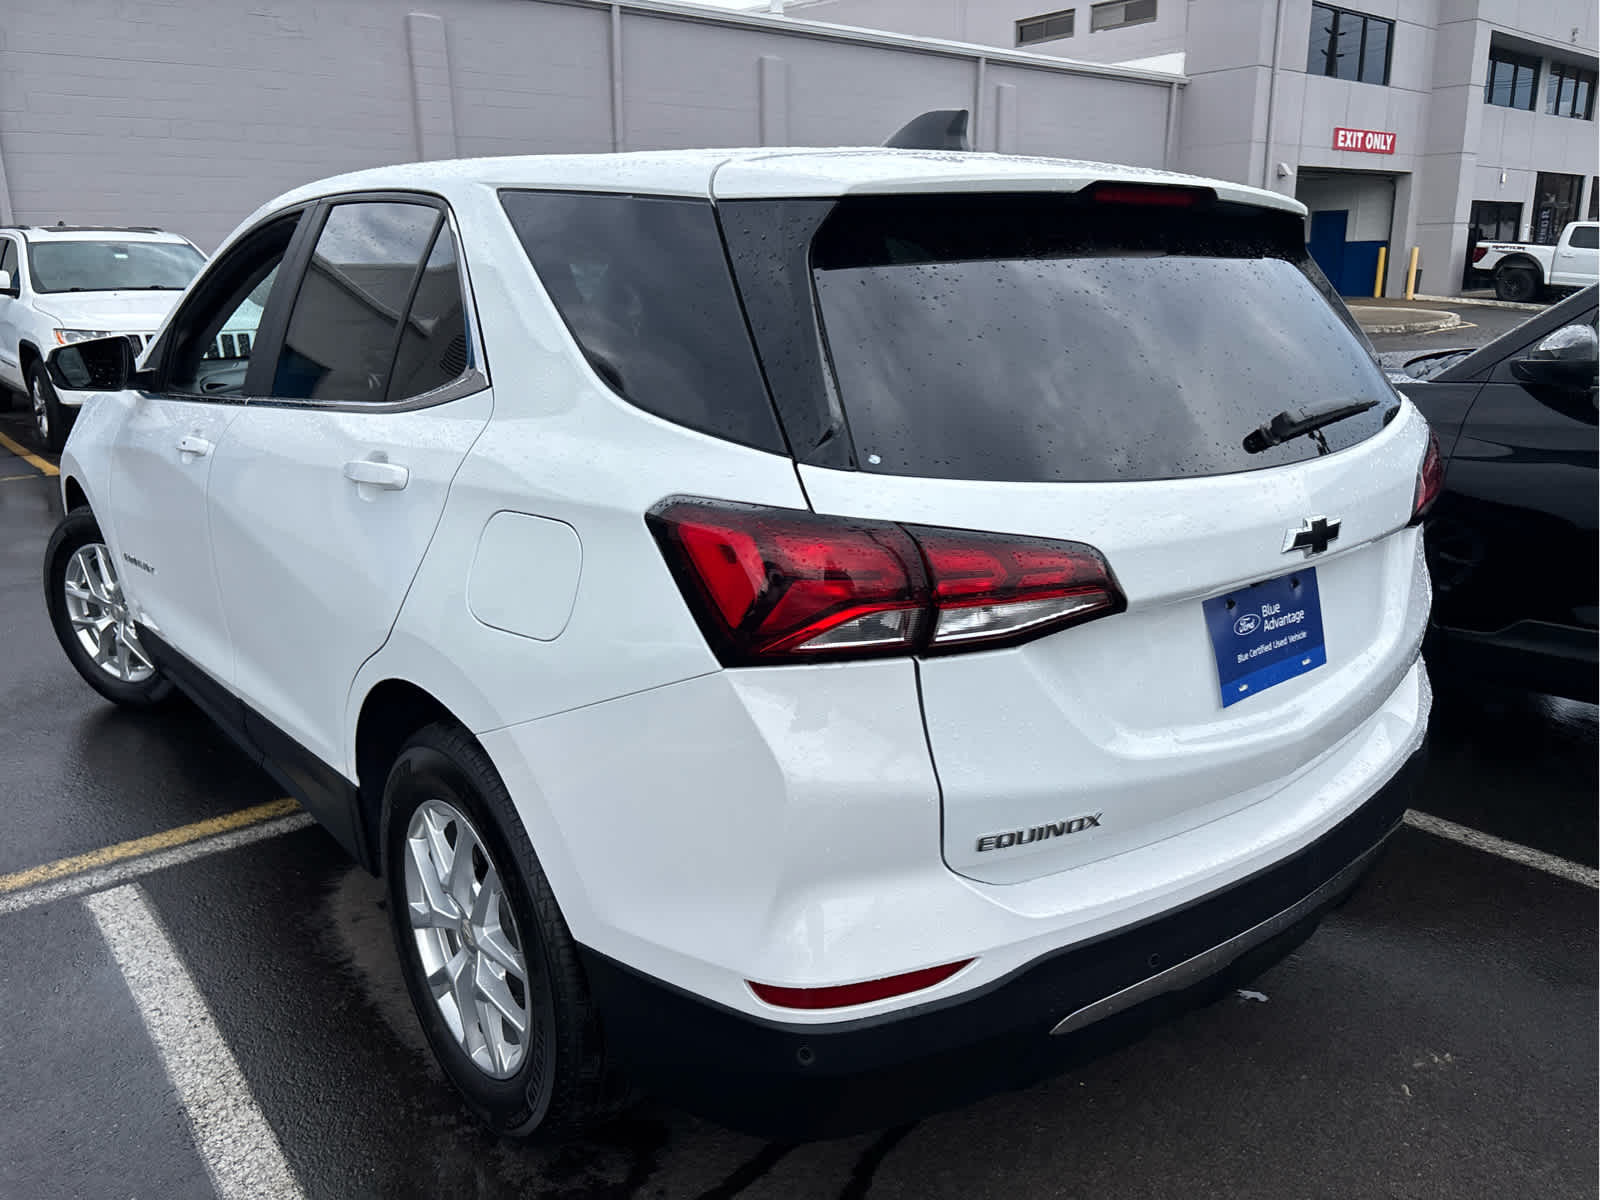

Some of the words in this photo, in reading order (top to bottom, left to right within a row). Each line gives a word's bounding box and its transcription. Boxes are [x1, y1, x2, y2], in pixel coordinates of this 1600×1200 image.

[1338, 130, 1364, 148] EXIT
[1365, 132, 1394, 151] ONLY
[1262, 603, 1280, 617] Blue
[1263, 610, 1304, 632] Advantage
[1237, 652, 1249, 663] Blue
[1249, 642, 1272, 657] Certified
[1272, 636, 1288, 648] Used
[976, 811, 1103, 852] EQUINOX
